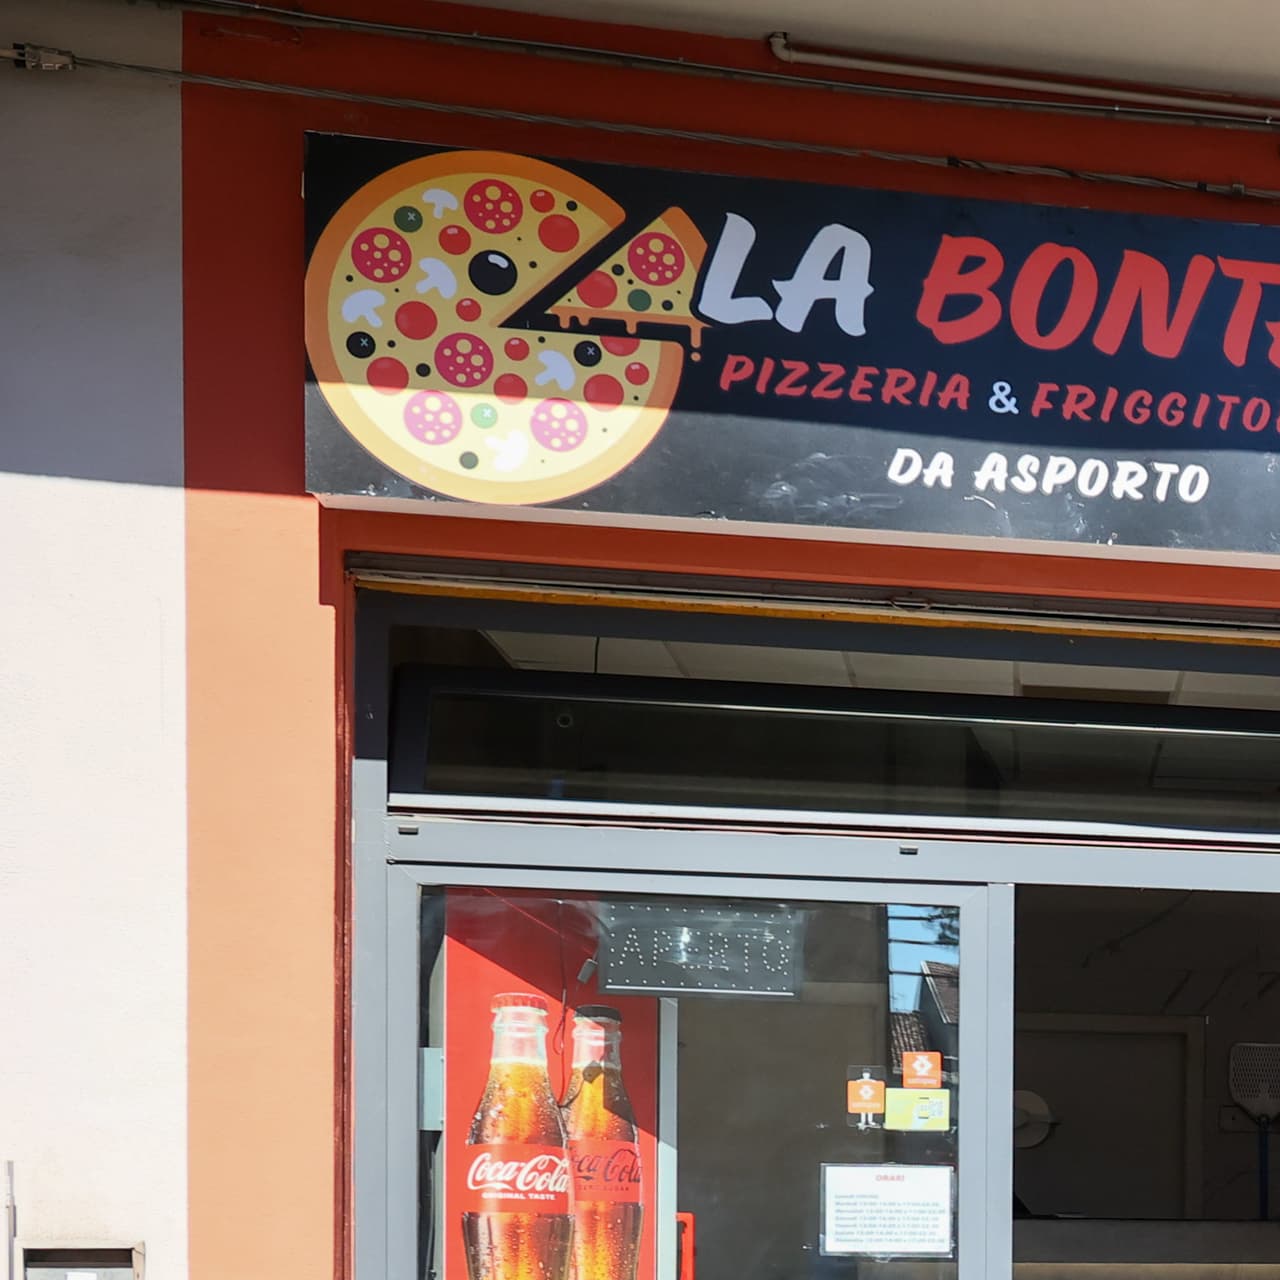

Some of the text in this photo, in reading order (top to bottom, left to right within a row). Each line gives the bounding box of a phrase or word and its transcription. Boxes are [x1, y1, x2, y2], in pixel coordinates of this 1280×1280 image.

[697, 212, 874, 337] LA
[720, 353, 971, 409] PIZZERIA
[988, 380, 1021, 415] &
[888, 446, 1210, 504] DA ASPORTO
[467, 1152, 568, 1193] Coca-Cola
